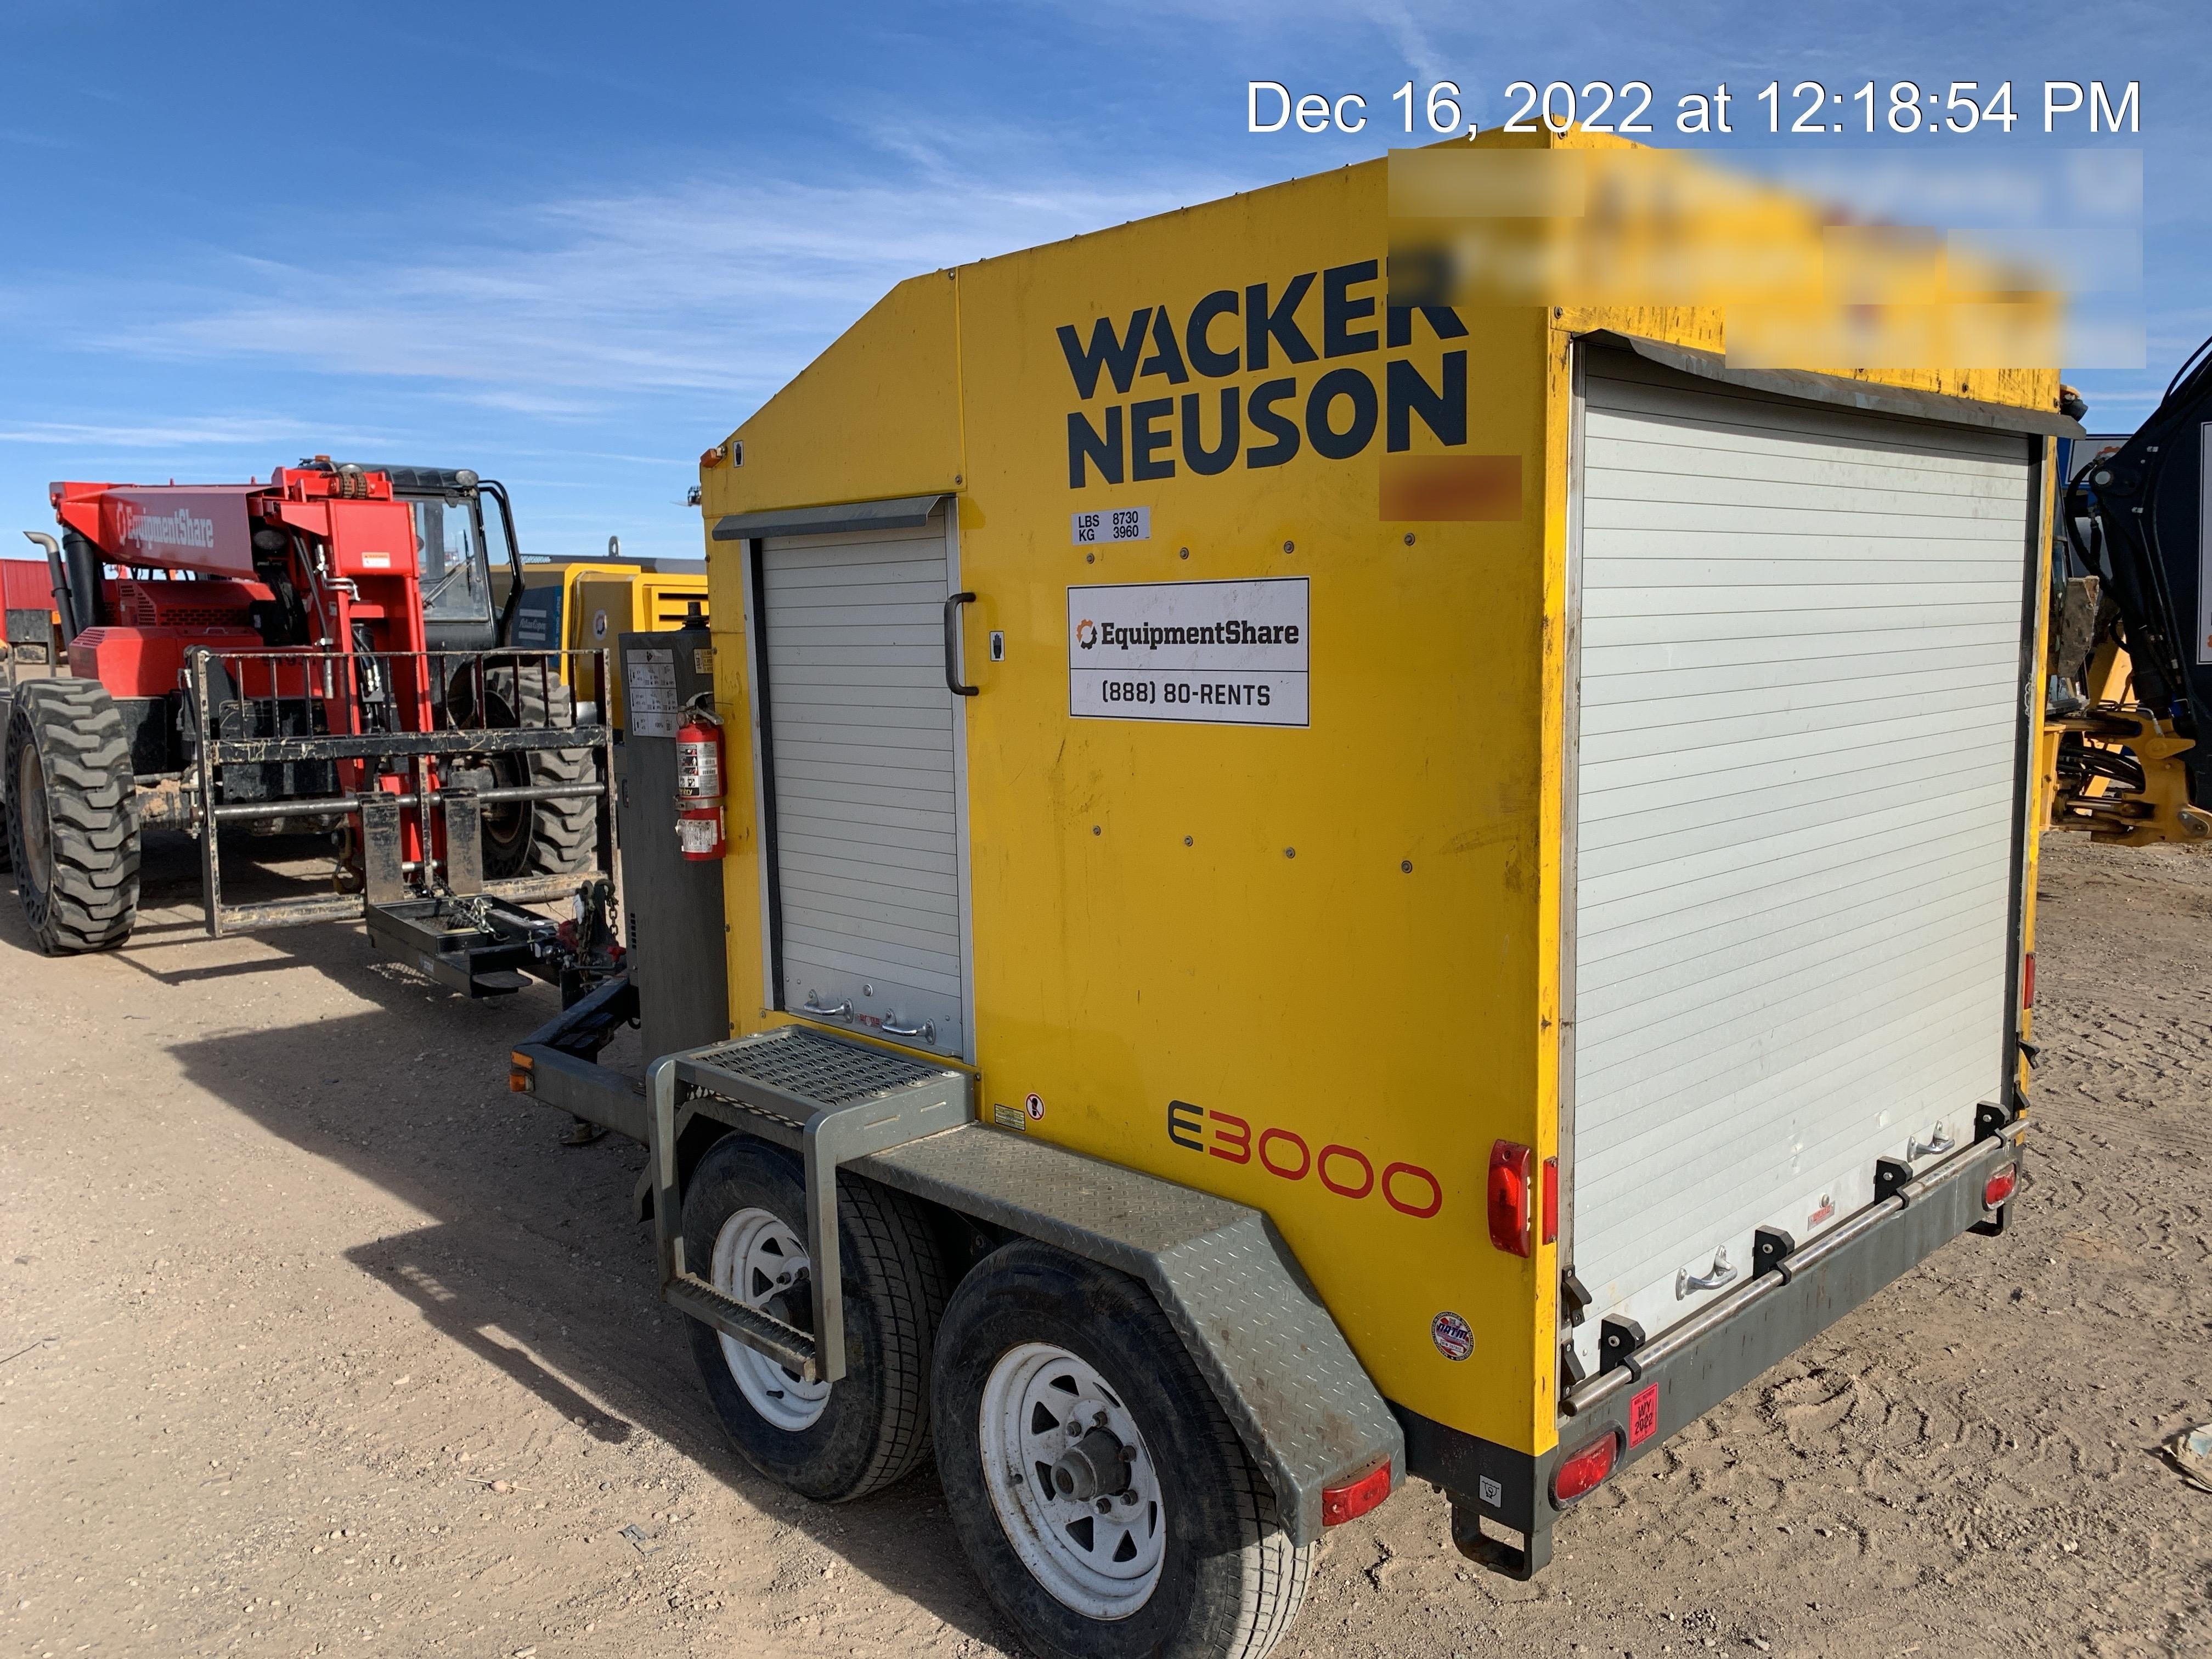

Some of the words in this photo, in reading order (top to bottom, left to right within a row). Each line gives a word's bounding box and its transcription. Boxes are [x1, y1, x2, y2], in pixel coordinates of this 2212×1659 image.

[1068, 350, 1467, 489] NEUSON
[126, 505, 214, 550] EquipmentShare
[1079, 515, 1099, 528] LBS
[1113, 511, 1138, 525] 8730
[1079, 529, 1095, 541] KG
[1113, 524, 1138, 538] 3960
[1101, 620, 1299, 650] EquipmentShare
[1102, 680, 1155, 704] (888)
[1164, 683, 1270, 706] 80-RENTS
[1168, 1101, 1442, 1218] E3000
[1638, 1399, 1651, 1418] WY
